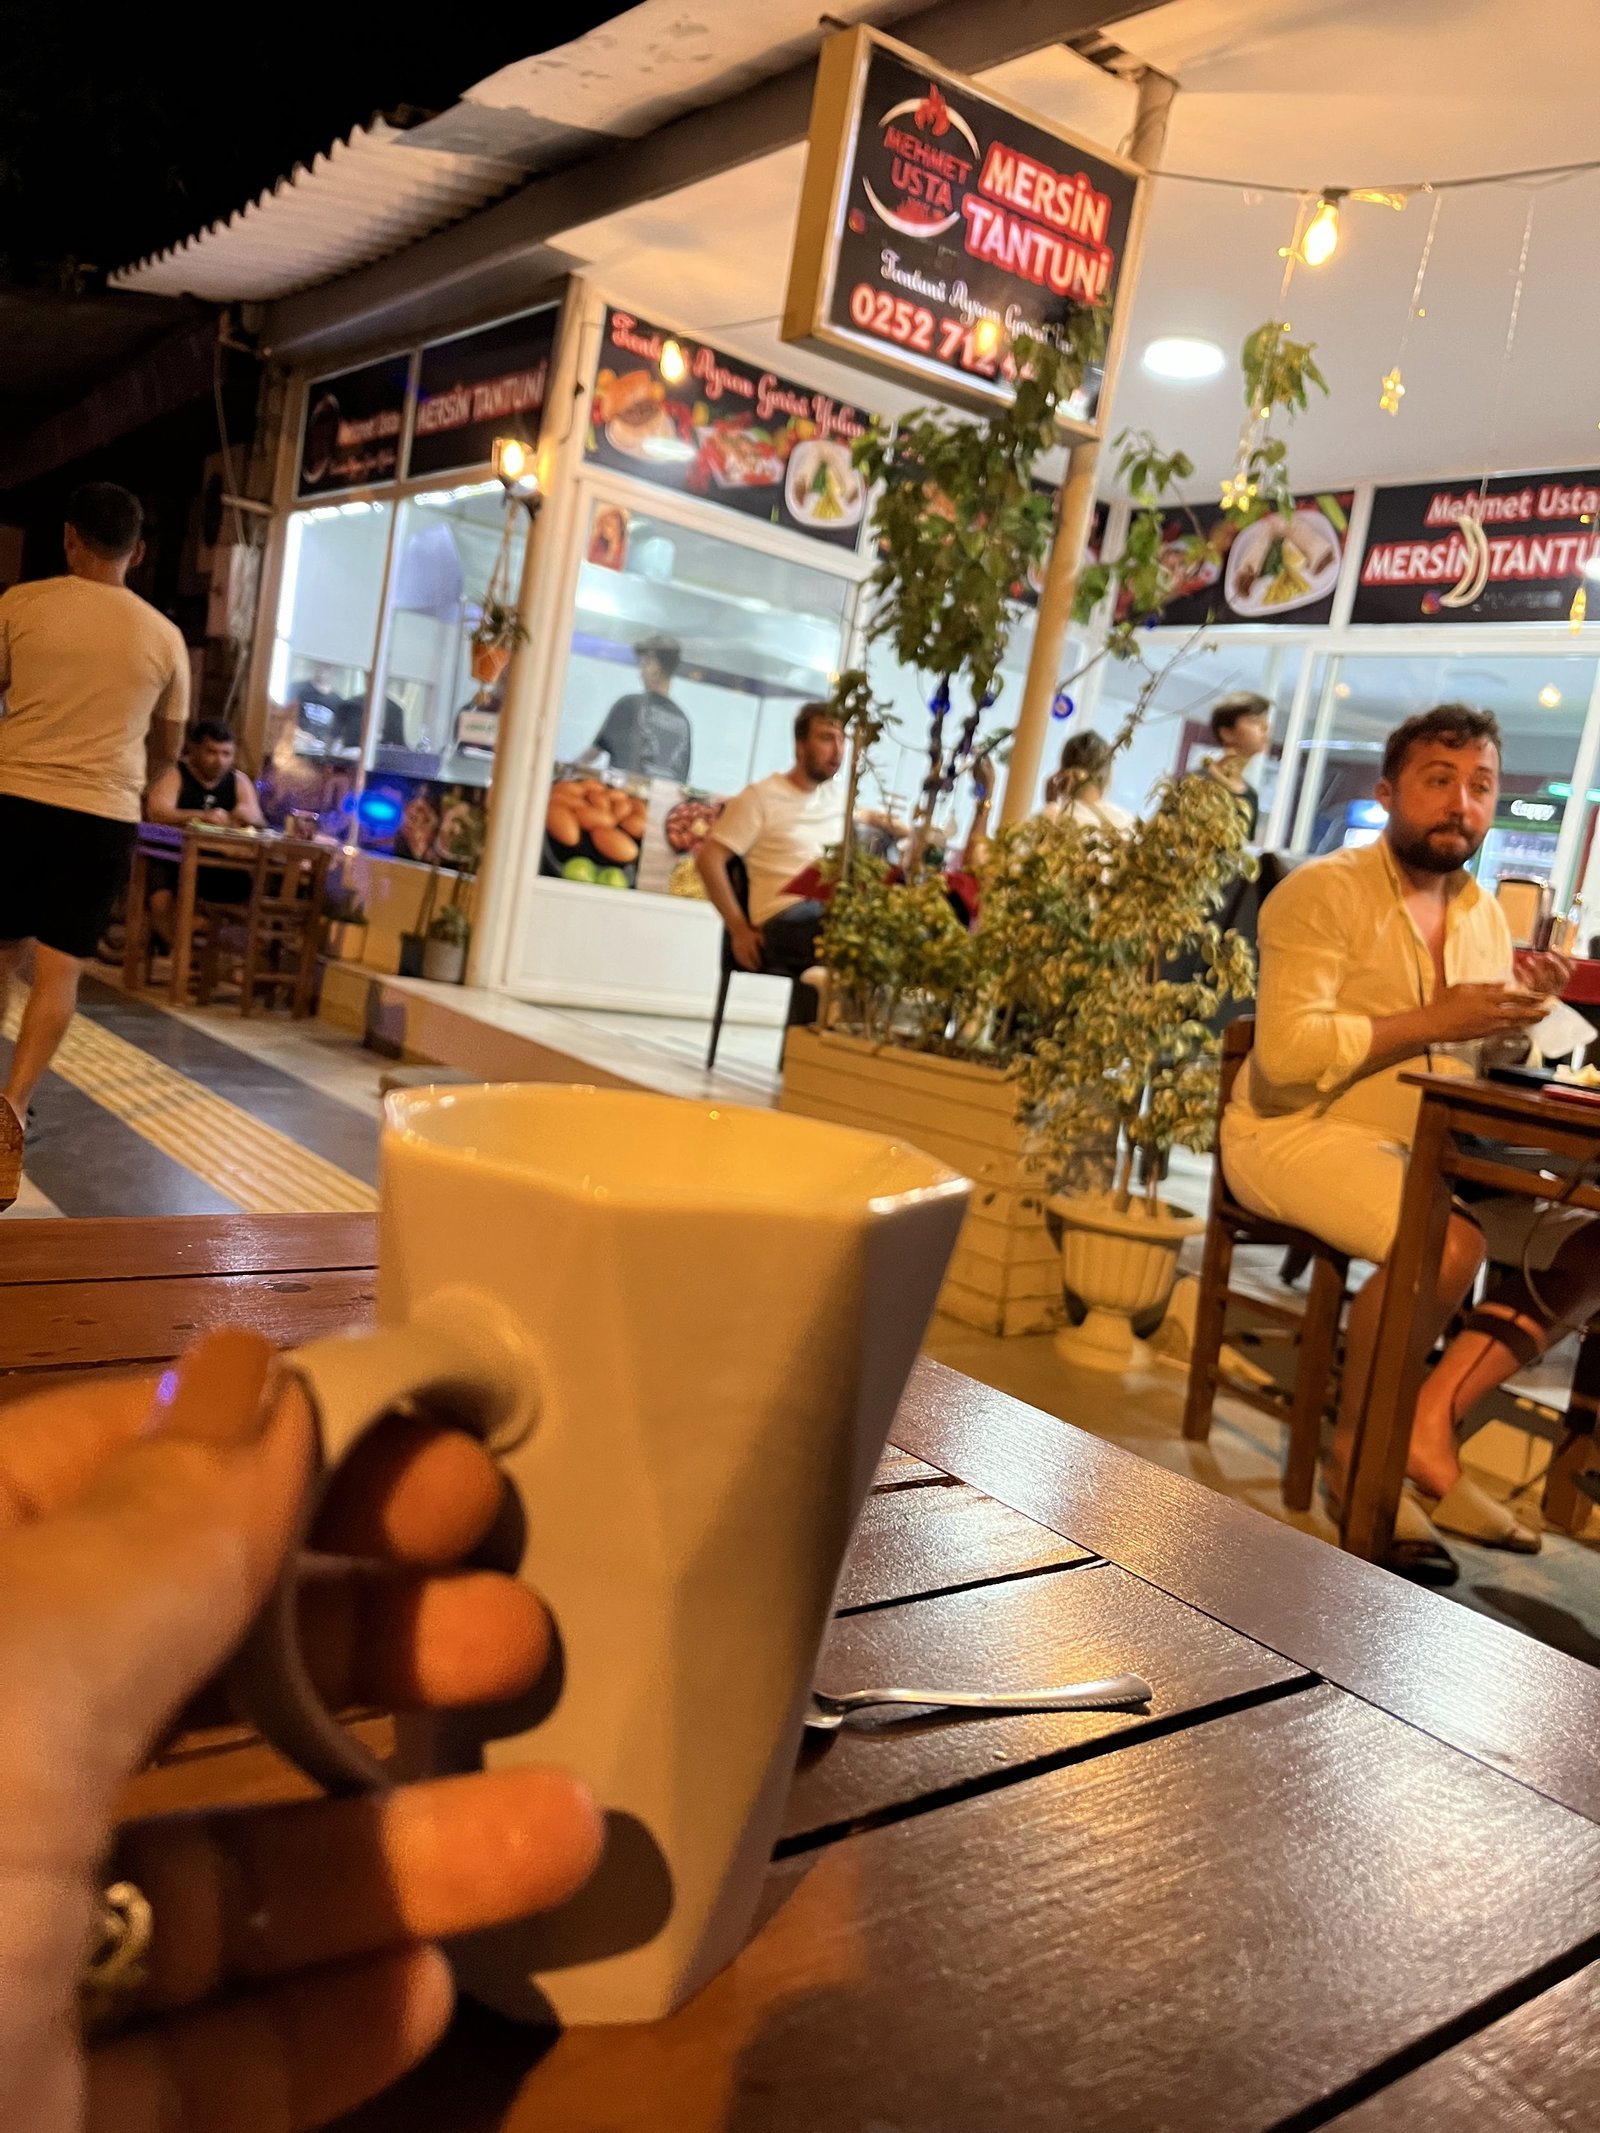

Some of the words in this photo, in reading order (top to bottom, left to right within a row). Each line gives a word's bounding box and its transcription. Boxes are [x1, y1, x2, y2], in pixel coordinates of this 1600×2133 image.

[884, 126, 973, 184] MEHMET
[892, 157, 954, 212] USTA
[981, 146, 1110, 245] MERSİN
[964, 198, 1112, 303] TANTUNİ
[851, 284, 935, 351] 0252
[1426, 490, 1532, 523] Mehmet
[1537, 486, 1599, 517] Usta
